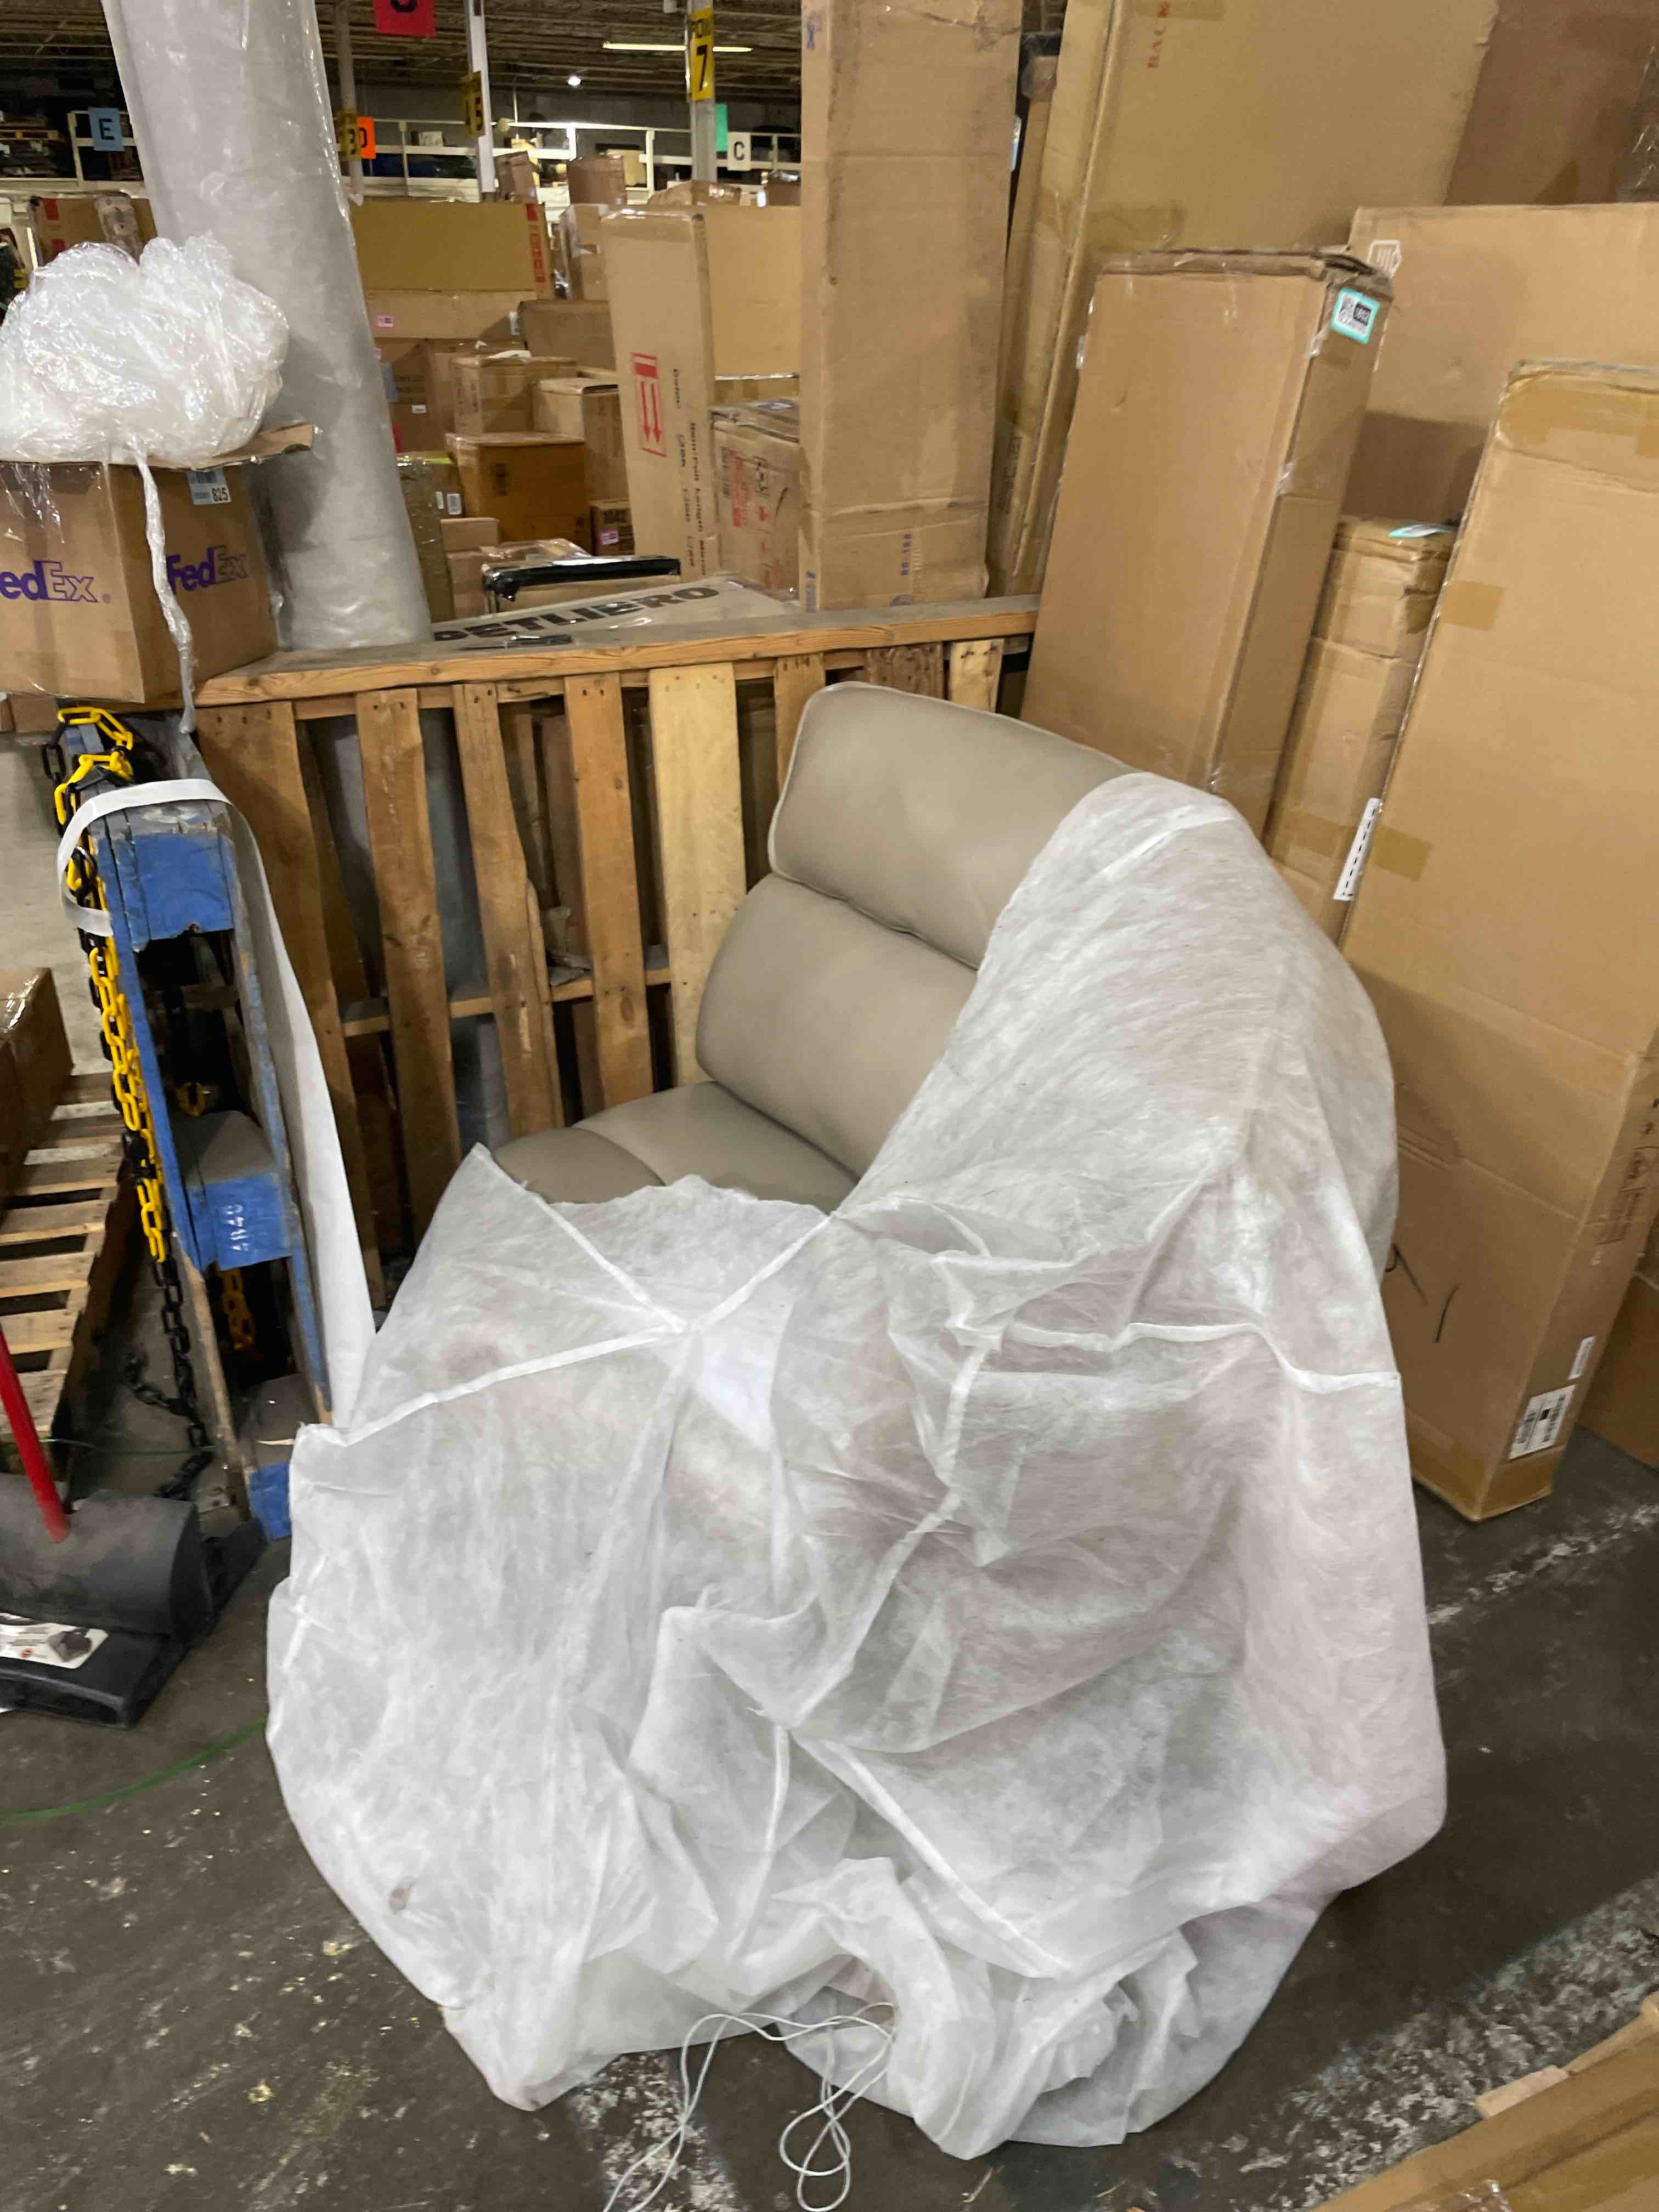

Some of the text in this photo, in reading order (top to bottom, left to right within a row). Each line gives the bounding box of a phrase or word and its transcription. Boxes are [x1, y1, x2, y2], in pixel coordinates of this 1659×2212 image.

[697, 44, 708, 92] 7
[99, 119, 115, 140] E
[734, 140, 744, 161] C
[0, 560, 98, 602] edEx
[166, 544, 249, 594] FedEx
